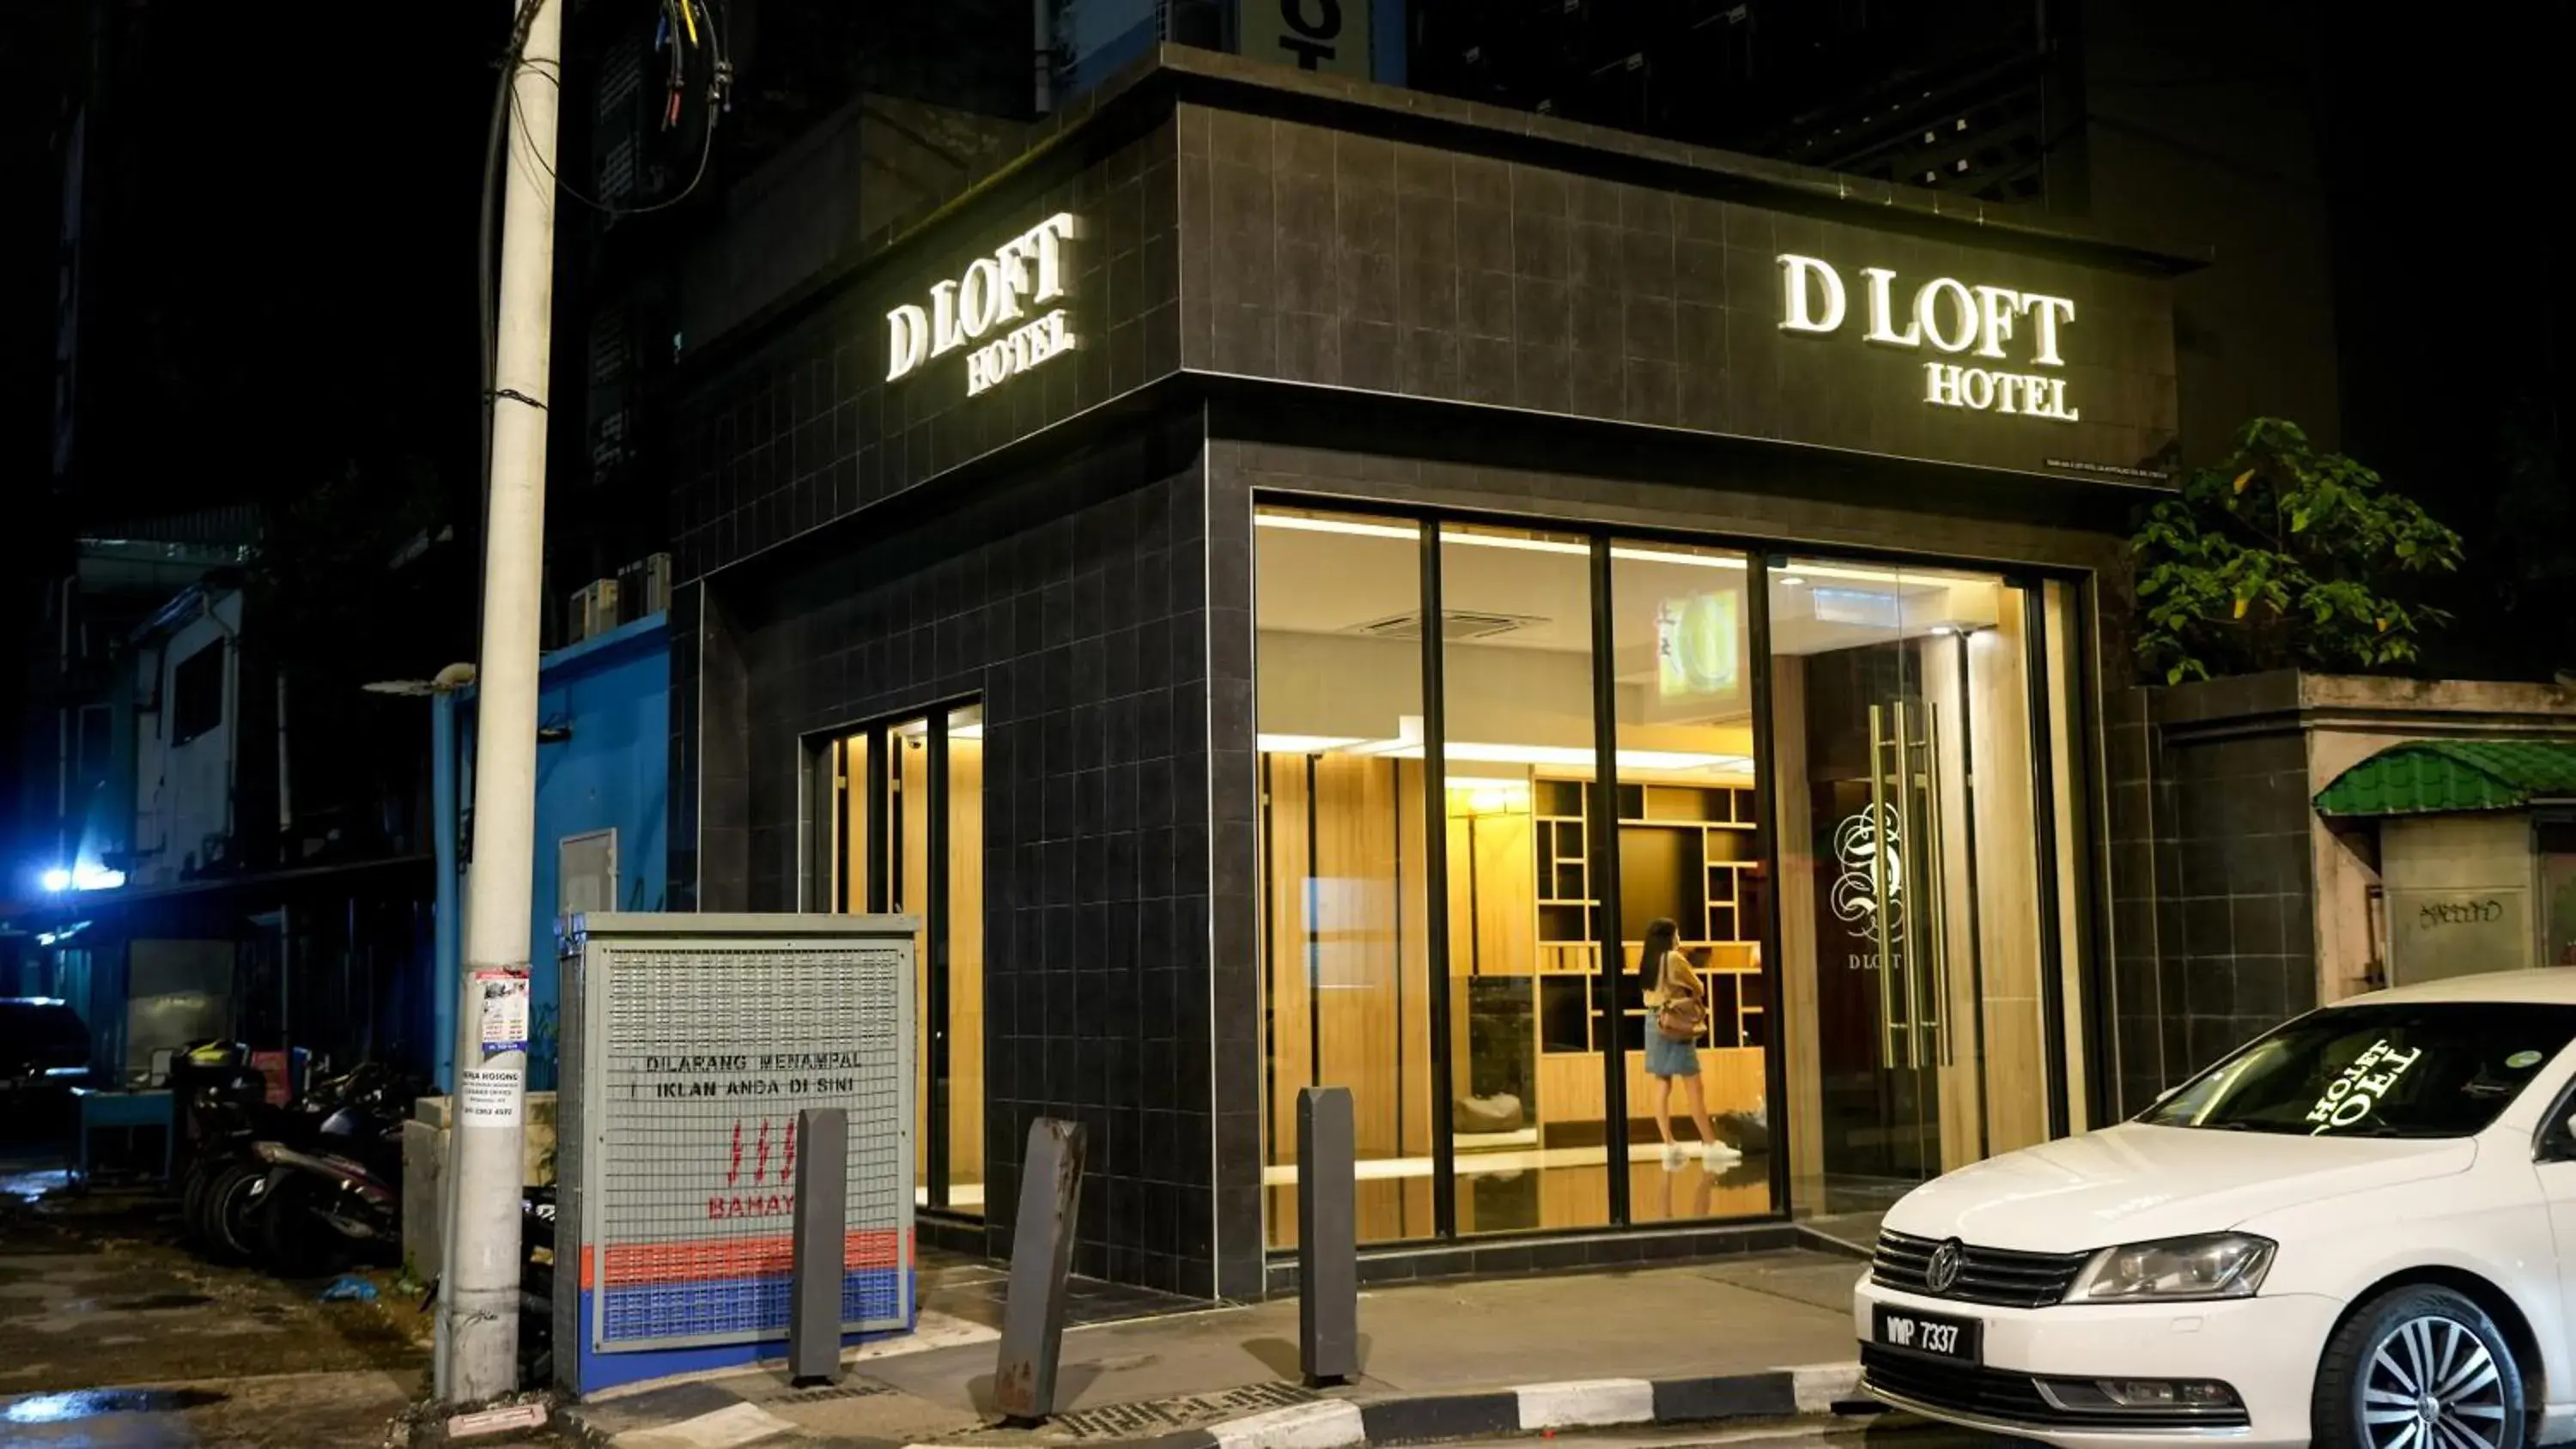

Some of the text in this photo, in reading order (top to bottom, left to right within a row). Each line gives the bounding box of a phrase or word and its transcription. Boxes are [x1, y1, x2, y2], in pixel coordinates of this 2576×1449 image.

[885, 212, 1076, 382] D LOFT
[1777, 253, 2075, 367] D LOFT
[966, 308, 1076, 397] HOTEL
[1923, 361, 2079, 421] HOTEL
[1862, 954, 1902, 969] LOT
[647, 1052, 861, 1072] DILARANG MENAMPAL
[657, 1077, 853, 1098] IKLAN ANDA DI SINI
[708, 1194, 795, 1219] BAHAY
[1920, 1321, 1959, 1354] 7337
